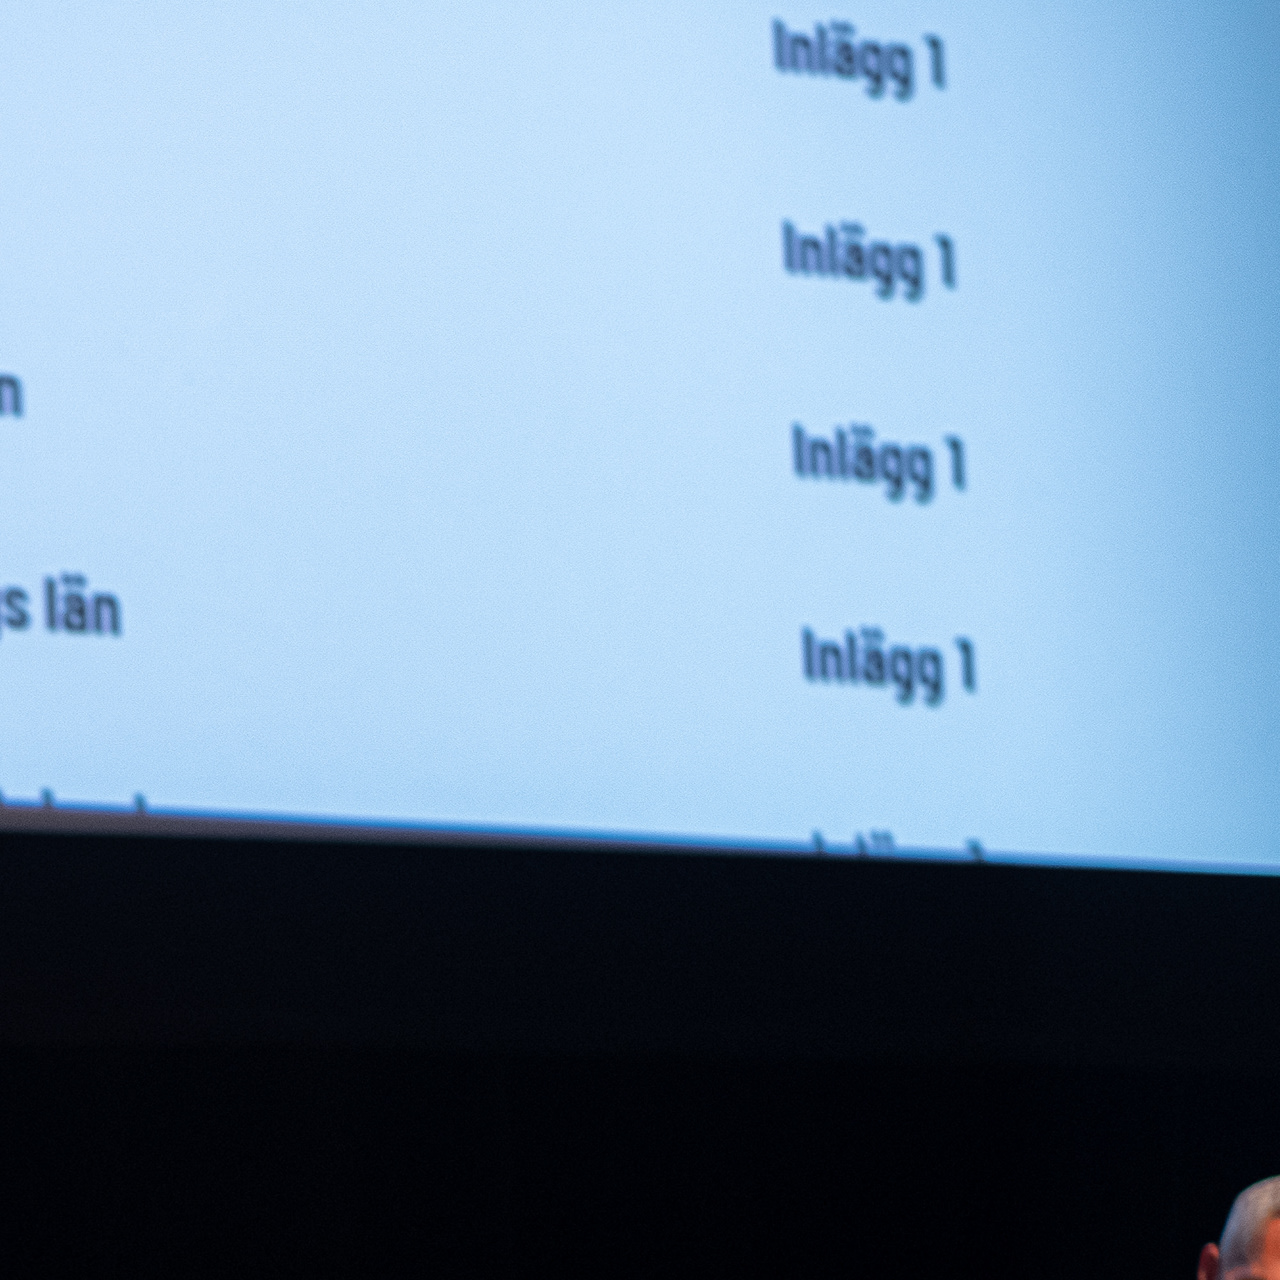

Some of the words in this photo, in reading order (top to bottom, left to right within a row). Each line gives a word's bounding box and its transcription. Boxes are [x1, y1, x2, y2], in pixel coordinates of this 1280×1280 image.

[772, 18, 916, 102] Inlägg
[923, 33, 947, 90] 1
[782, 219, 926, 303] Inlägg
[934, 233, 957, 290] 1
[792, 423, 936, 505] Inlägg
[944, 435, 967, 491] 1
[43, 573, 122, 637] län
[801, 626, 946, 708] Inlägg
[955, 636, 977, 694] 1
